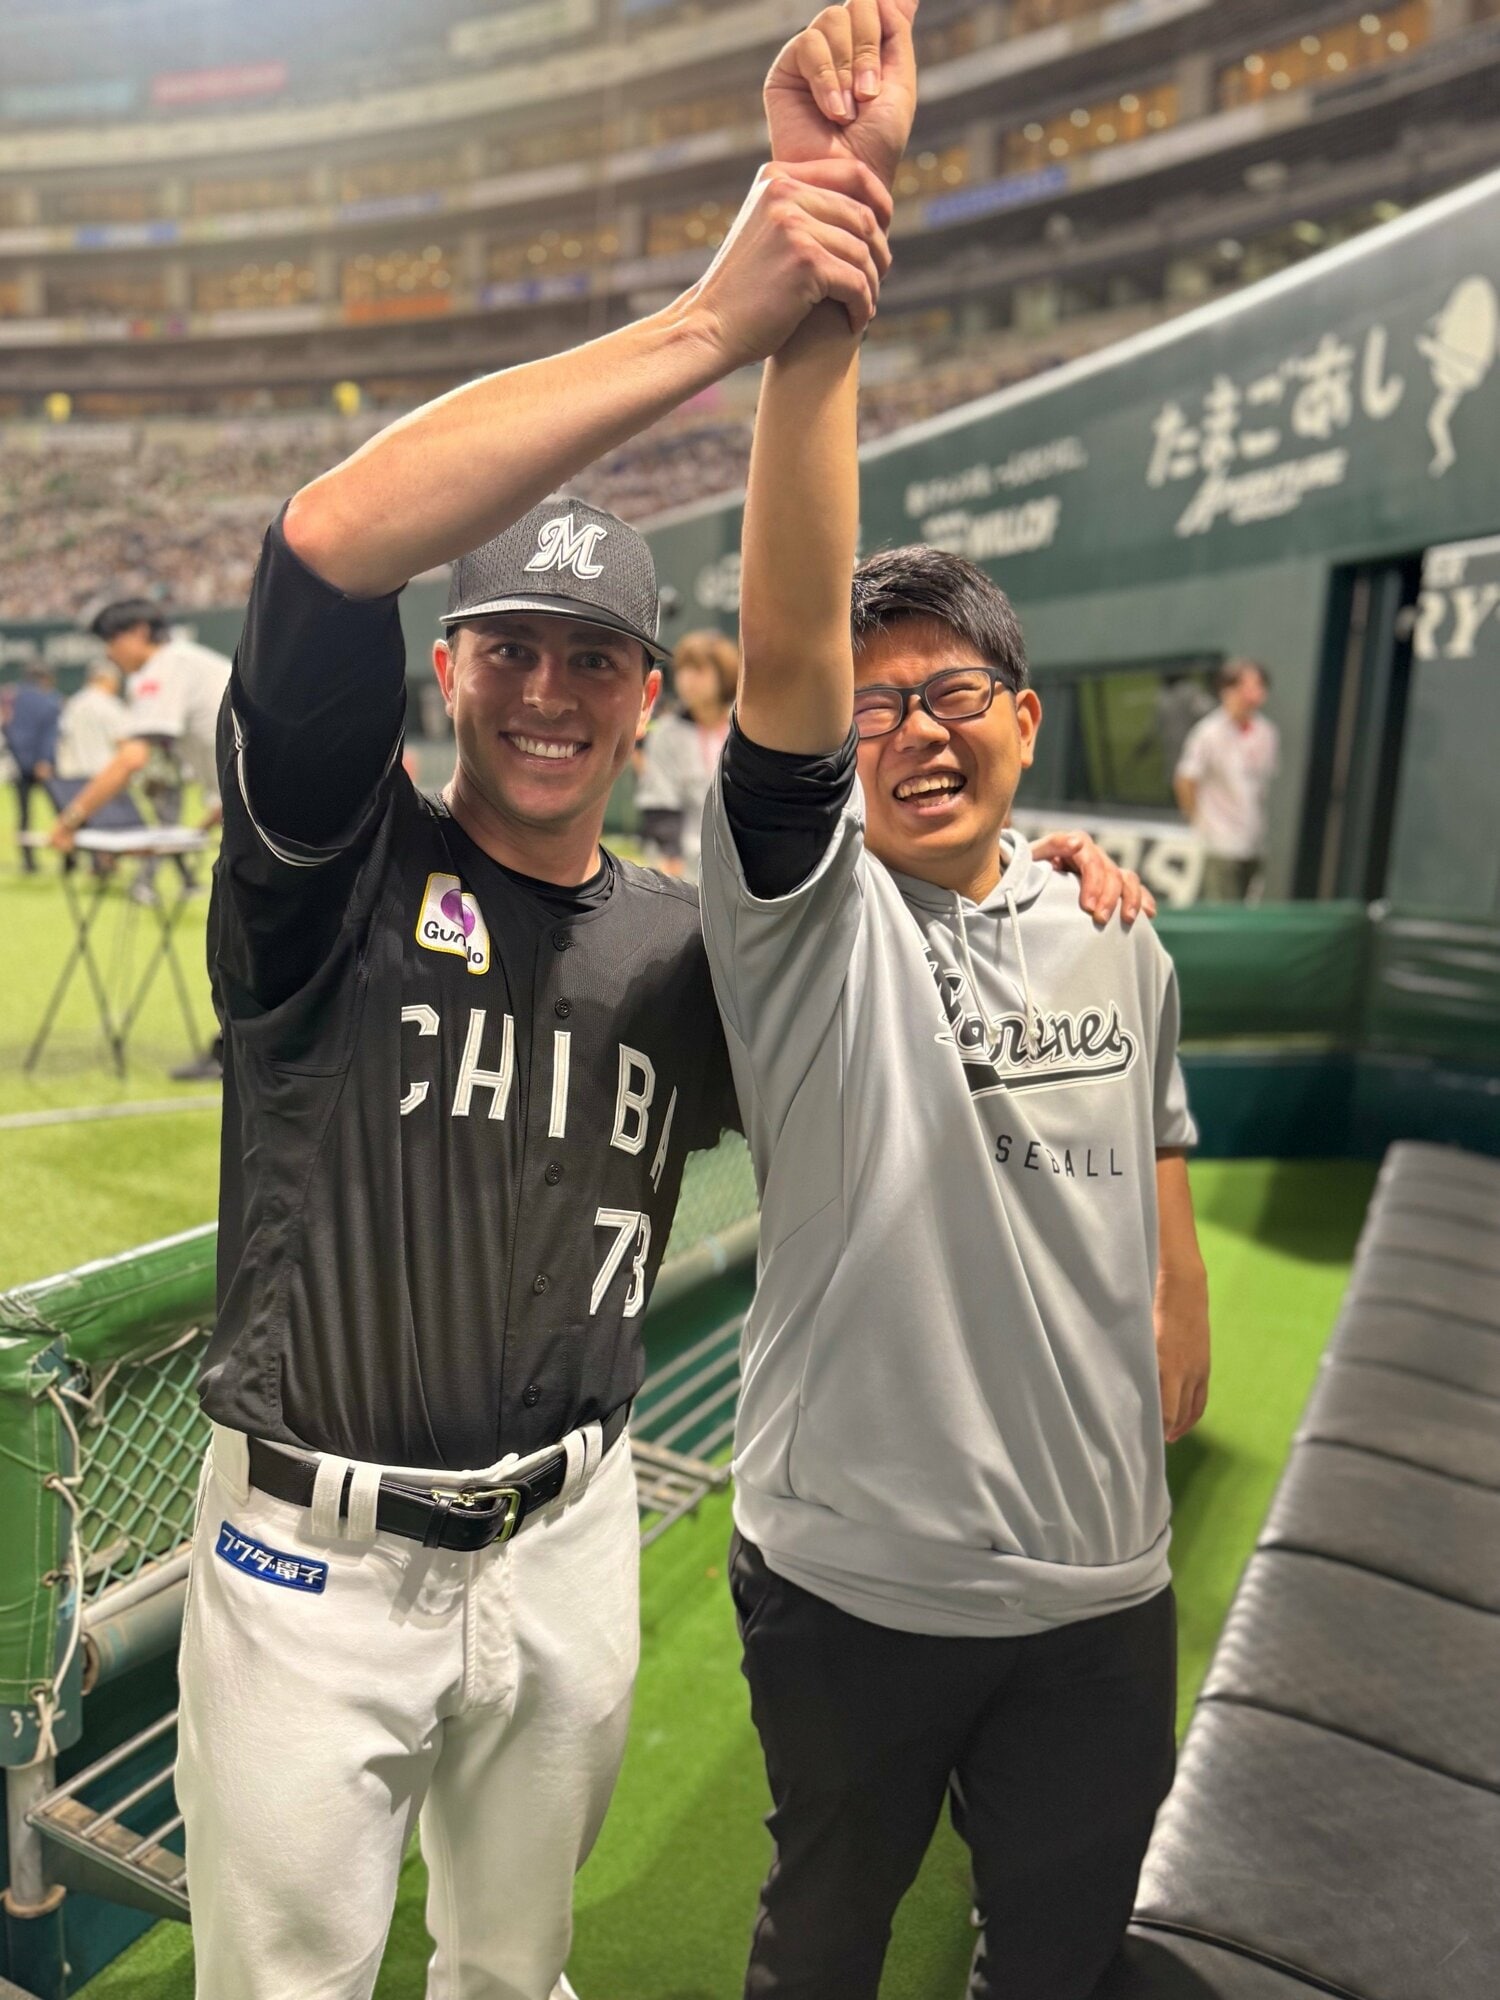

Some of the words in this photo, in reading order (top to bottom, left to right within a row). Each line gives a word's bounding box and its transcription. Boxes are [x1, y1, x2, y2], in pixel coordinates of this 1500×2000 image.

[524, 513, 607, 579] M
[589, 1207, 651, 1318] 73
[222, 1529, 323, 1584] フクダ電子
